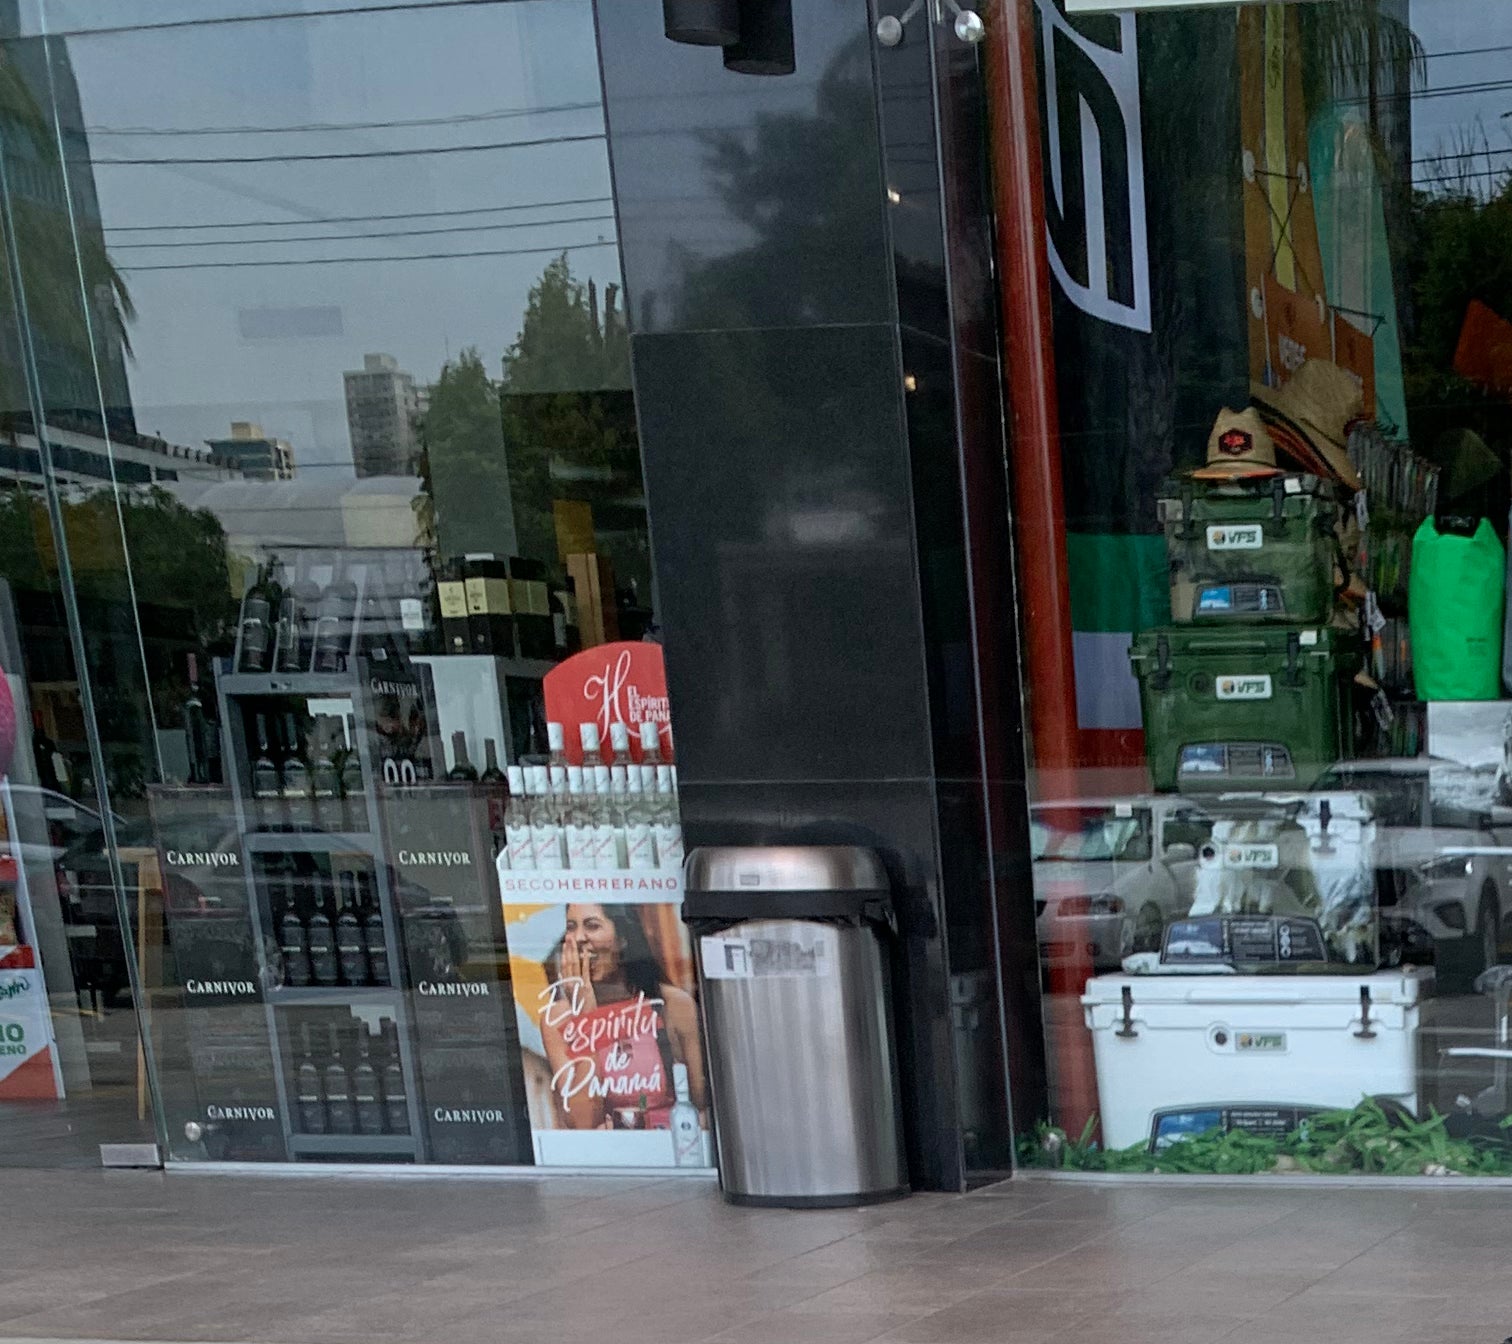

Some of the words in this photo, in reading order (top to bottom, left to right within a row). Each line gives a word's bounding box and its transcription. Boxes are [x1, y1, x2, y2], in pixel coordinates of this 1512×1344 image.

[166, 850, 239, 867] CARNIVOR
[399, 850, 471, 866] CARNIVOR
[186, 979, 256, 996] CARNIVOR
[419, 980, 490, 997] CARNIVOR
[538, 976, 585, 1027] El
[605, 1041, 630, 1071] de
[551, 1056, 661, 1112] Panamá
[207, 1105, 275, 1121] CARNIVOR
[434, 1107, 504, 1124] CARNIVOR
